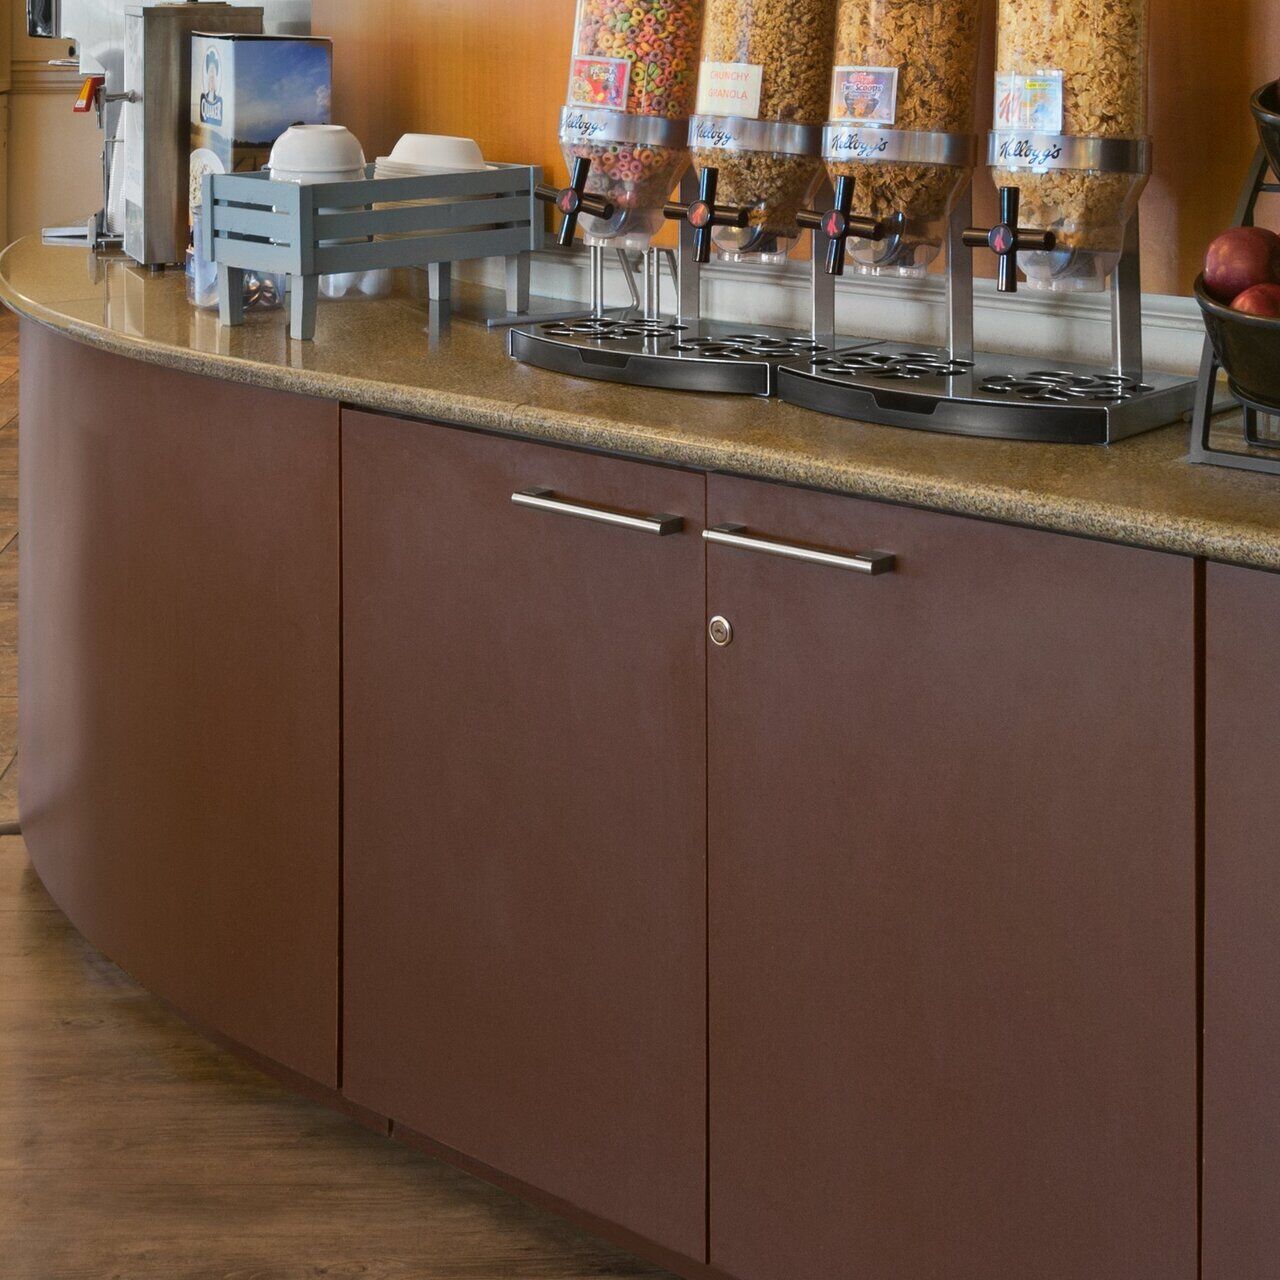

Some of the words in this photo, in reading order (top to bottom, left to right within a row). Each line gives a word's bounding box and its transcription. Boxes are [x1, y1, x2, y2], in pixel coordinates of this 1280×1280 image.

[710, 71, 751, 82] CRUNCHY
[708, 88, 748, 100] GRANOLA
[1000, 137, 1062, 165] Kellogg's
